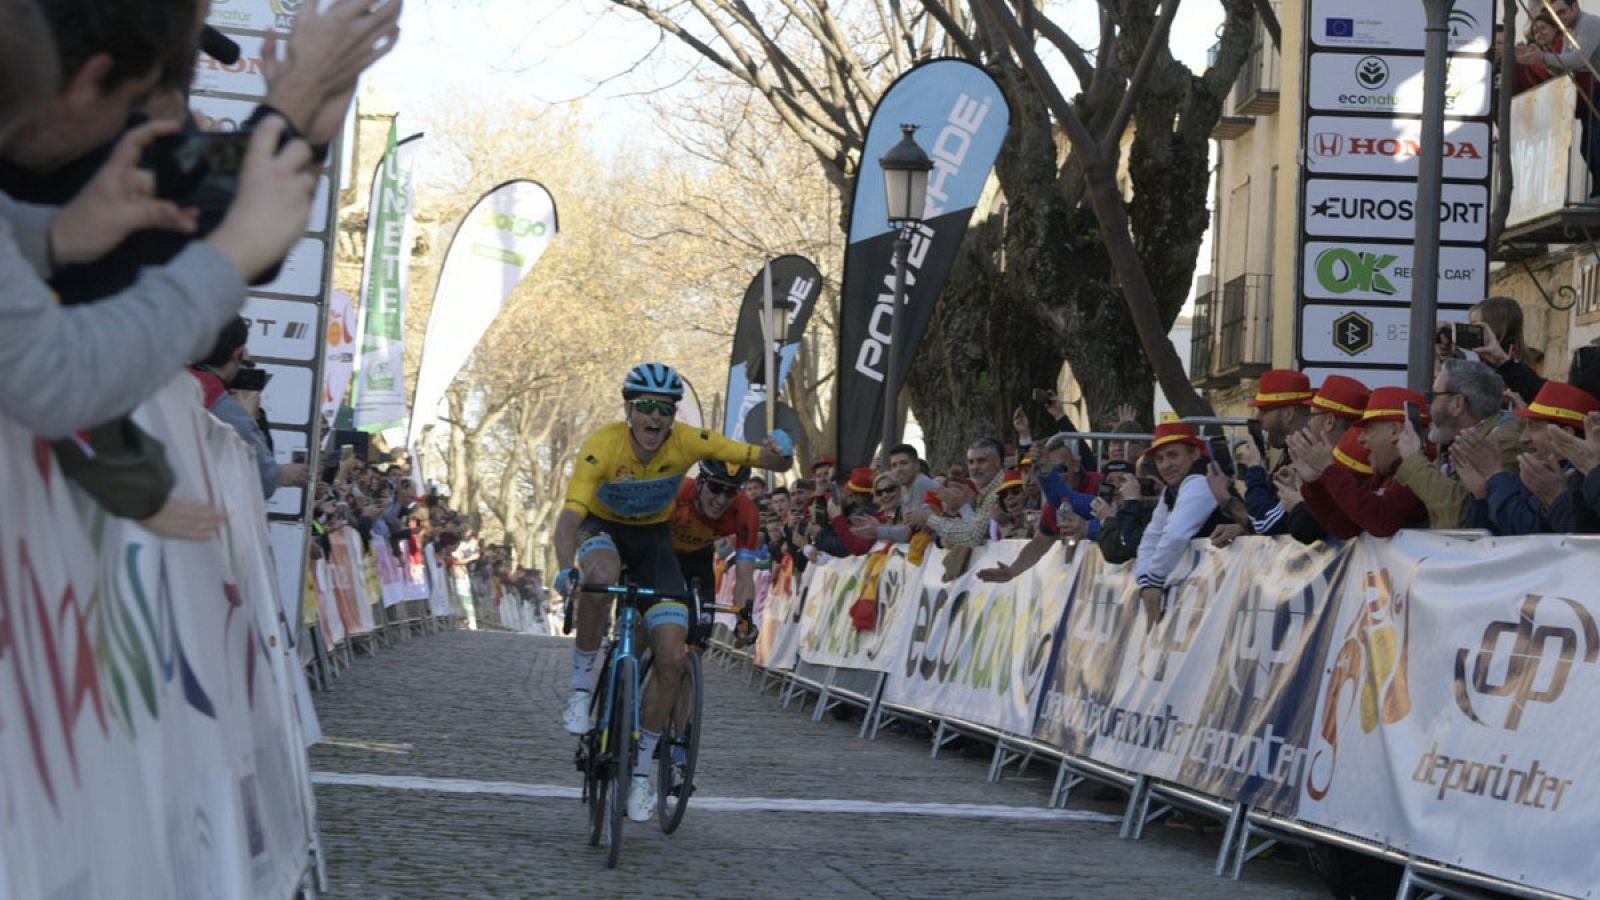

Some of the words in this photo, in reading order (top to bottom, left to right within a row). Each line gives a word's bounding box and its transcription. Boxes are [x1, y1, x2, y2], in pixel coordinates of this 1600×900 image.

[1338, 92, 1403, 106] econatu
[1328, 197, 1484, 224] EUROSORT
[1315, 247, 1399, 296] OK
[1444, 268, 1471, 280] CAR
[1412, 742, 1573, 811] deporinter
